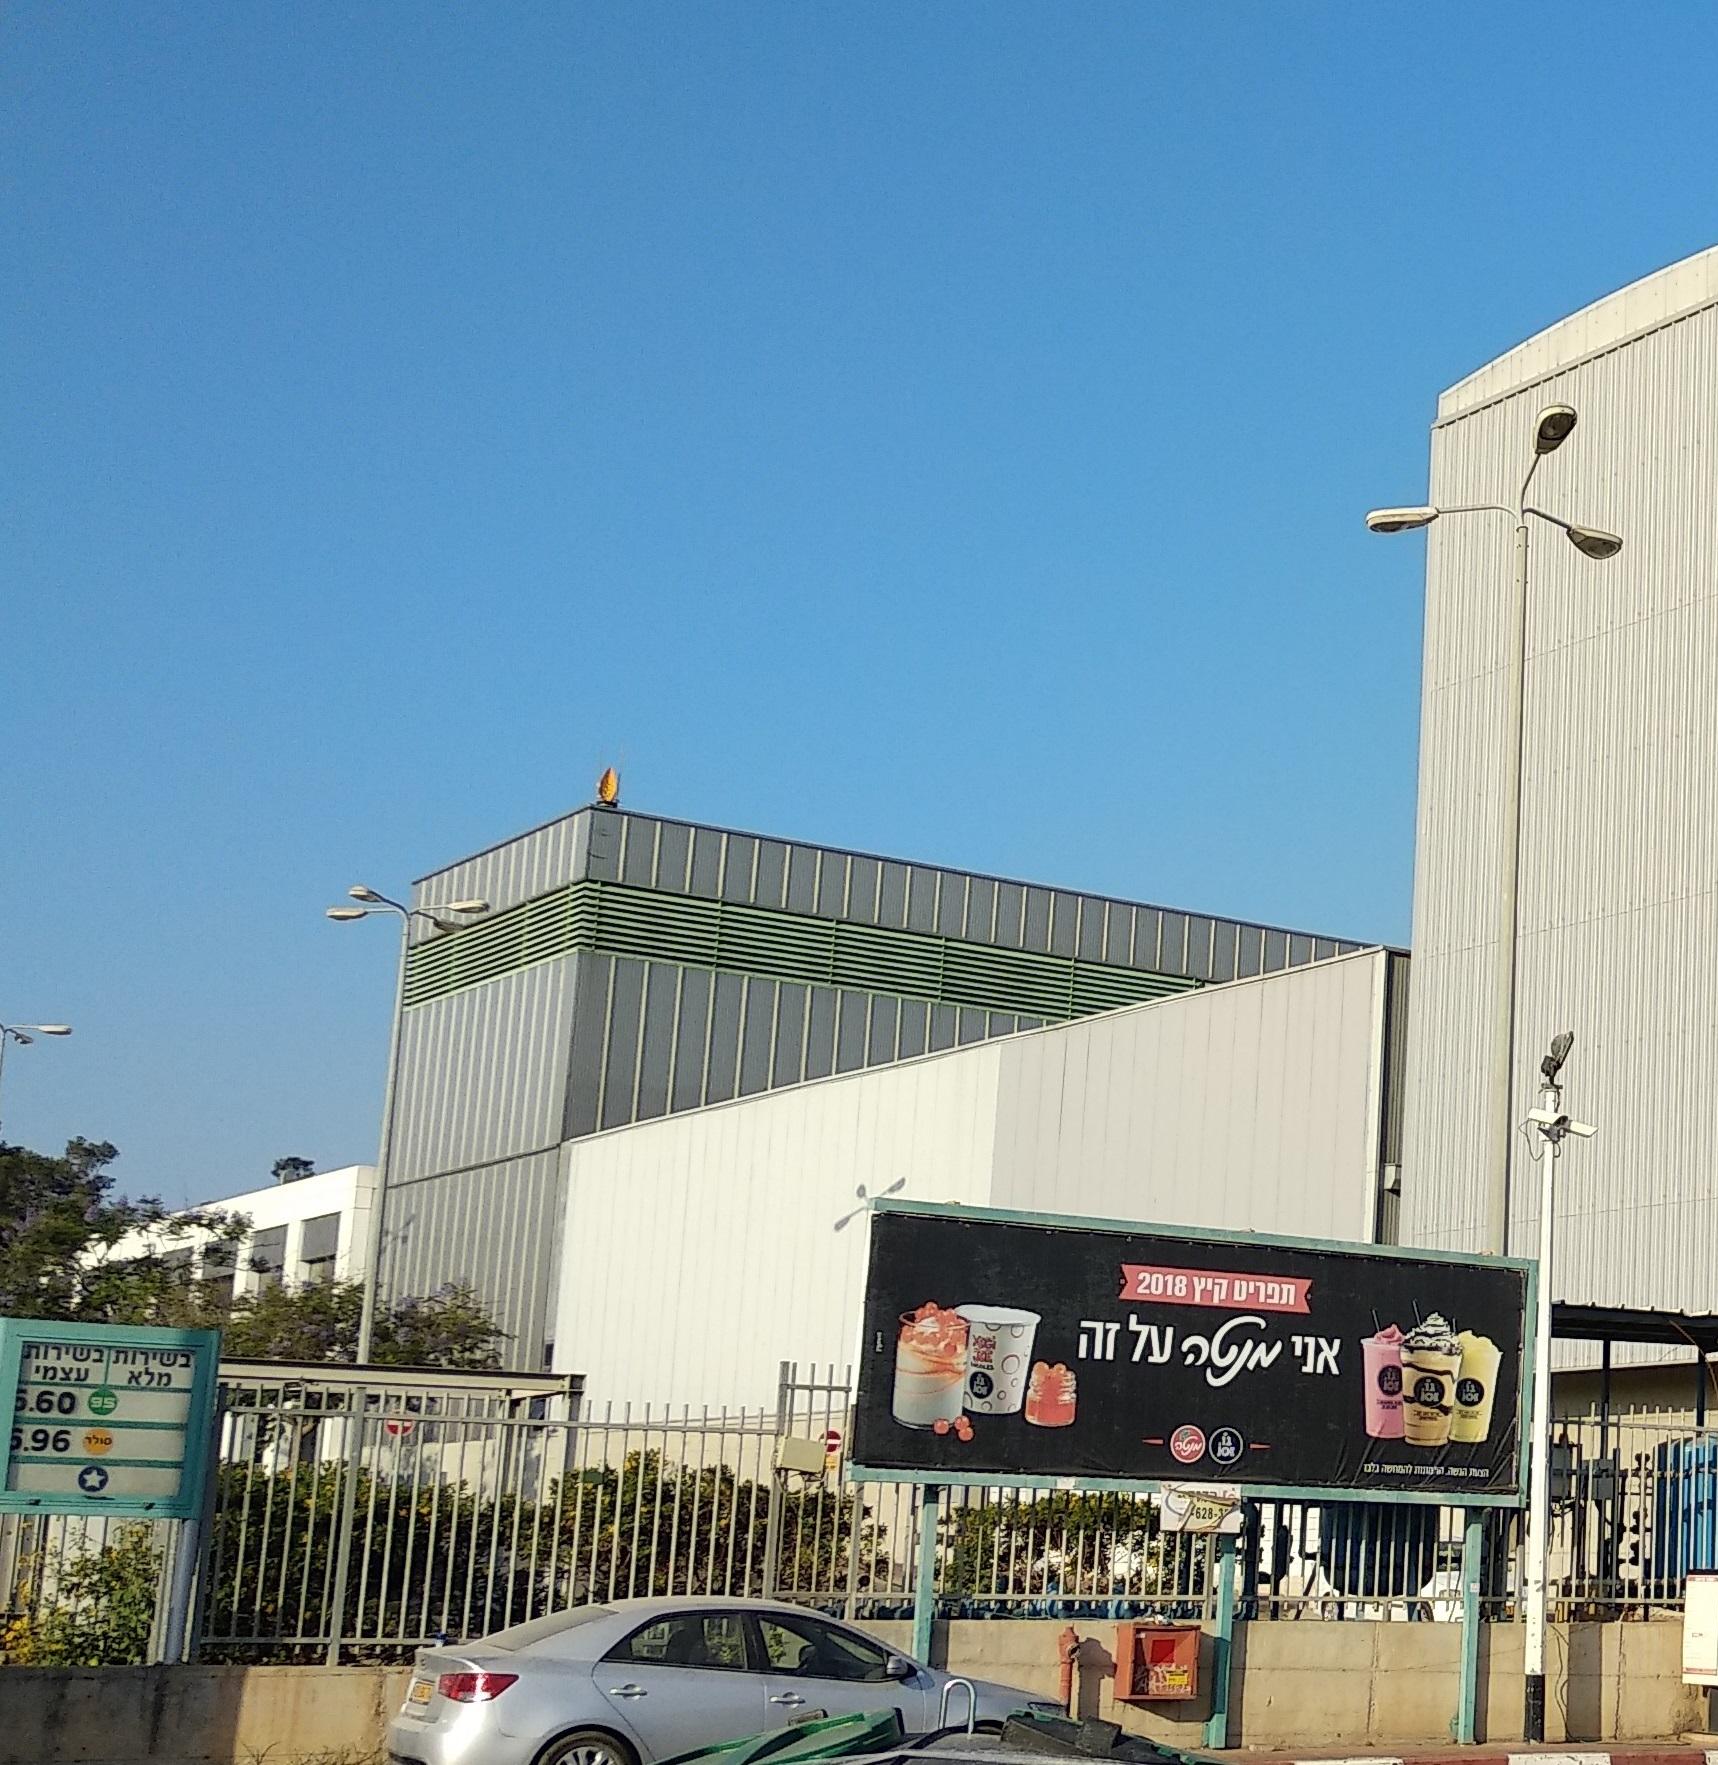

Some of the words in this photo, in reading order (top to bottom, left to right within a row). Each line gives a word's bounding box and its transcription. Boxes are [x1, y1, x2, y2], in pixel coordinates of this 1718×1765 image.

[1137, 1272, 1187, 1297] 2018
[1192, 1275, 1229, 1304] קיץ
[1233, 1280, 1296, 1306] תפריט
[1078, 1320, 1120, 1360] זה
[1128, 1313, 1174, 1363] על
[22, 1344, 104, 1363] בשירות
[112, 1350, 192, 1368] בשירות
[1181, 1315, 1282, 1387] מנטה
[1291, 1335, 1341, 1375] אני
[34, 1364, 90, 1382] עצמי
[128, 1367, 172, 1386] מלא
[85, 1435, 113, 1446] סולר
